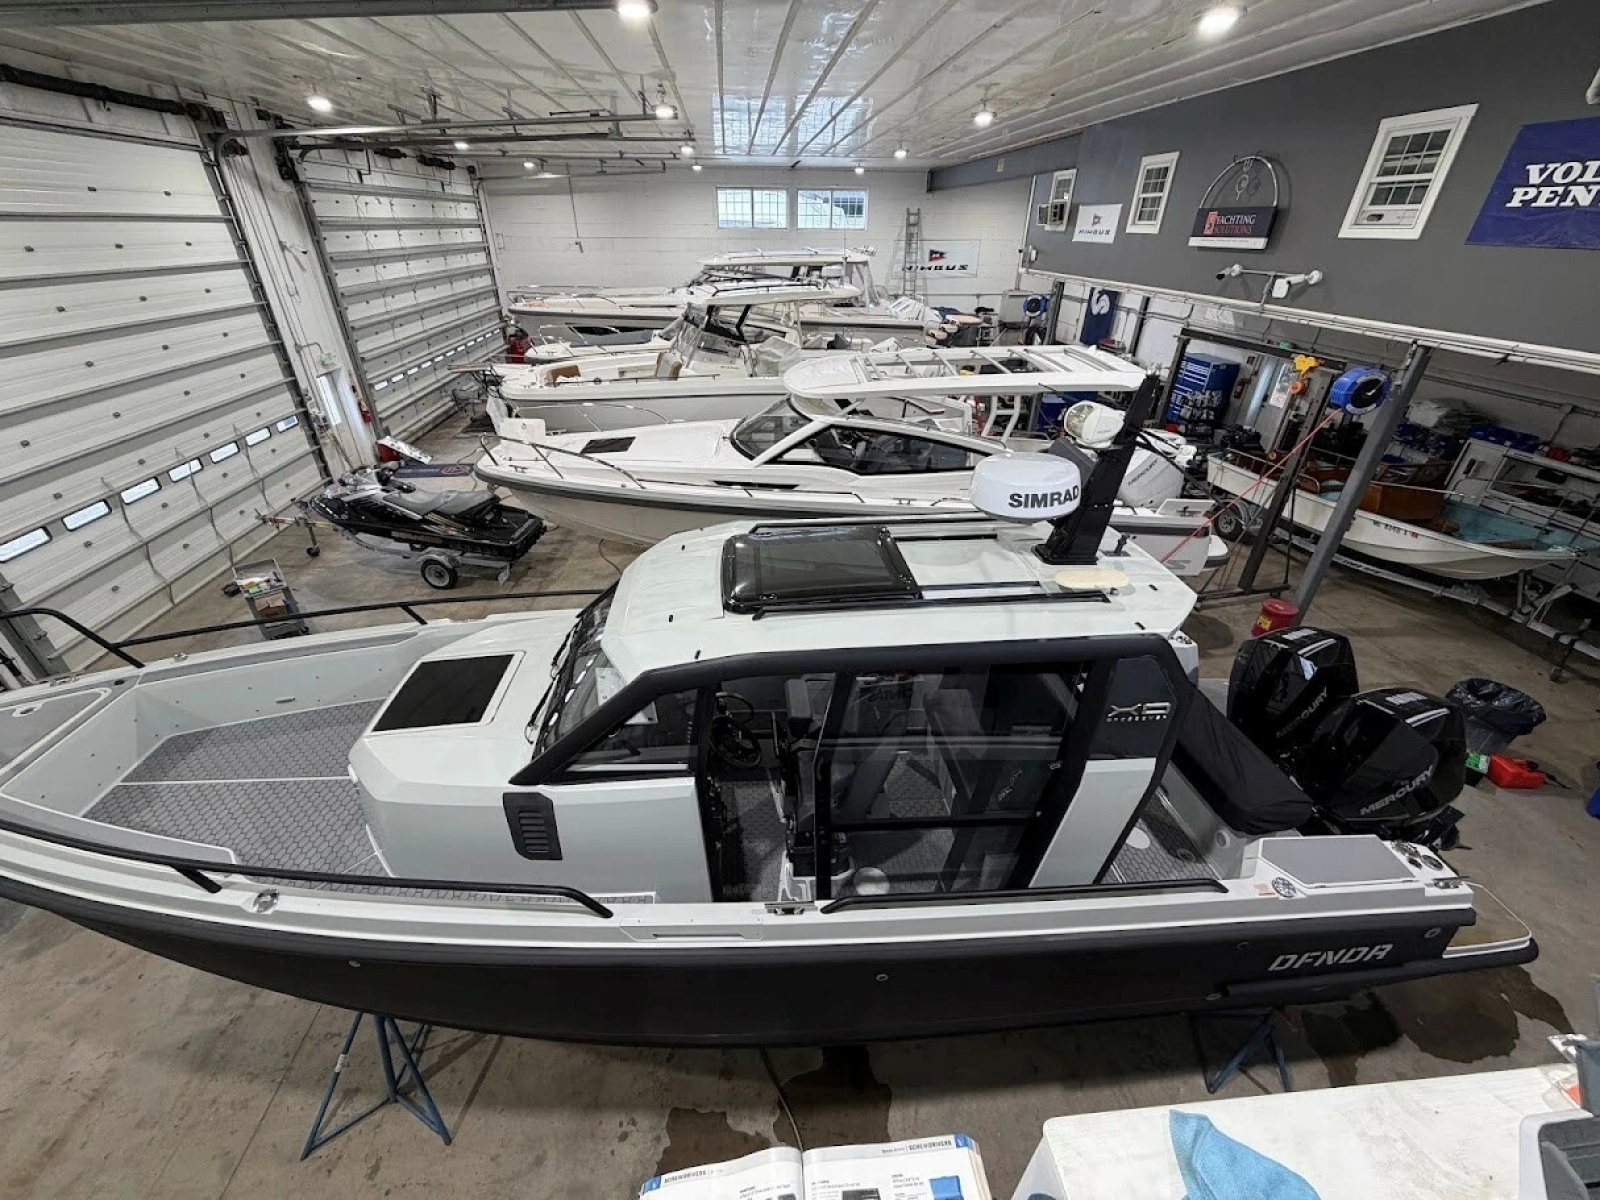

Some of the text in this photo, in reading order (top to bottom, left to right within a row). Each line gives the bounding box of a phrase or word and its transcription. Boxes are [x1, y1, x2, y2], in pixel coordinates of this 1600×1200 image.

[1526, 160, 1600, 185] VOL
[1505, 185, 1600, 207] PEN
[1214, 214, 1257, 225] YACHTING
[1008, 484, 1079, 509] SIMRAD
[1276, 686, 1328, 739] MERCURY
[1360, 764, 1434, 816] MERCURY
